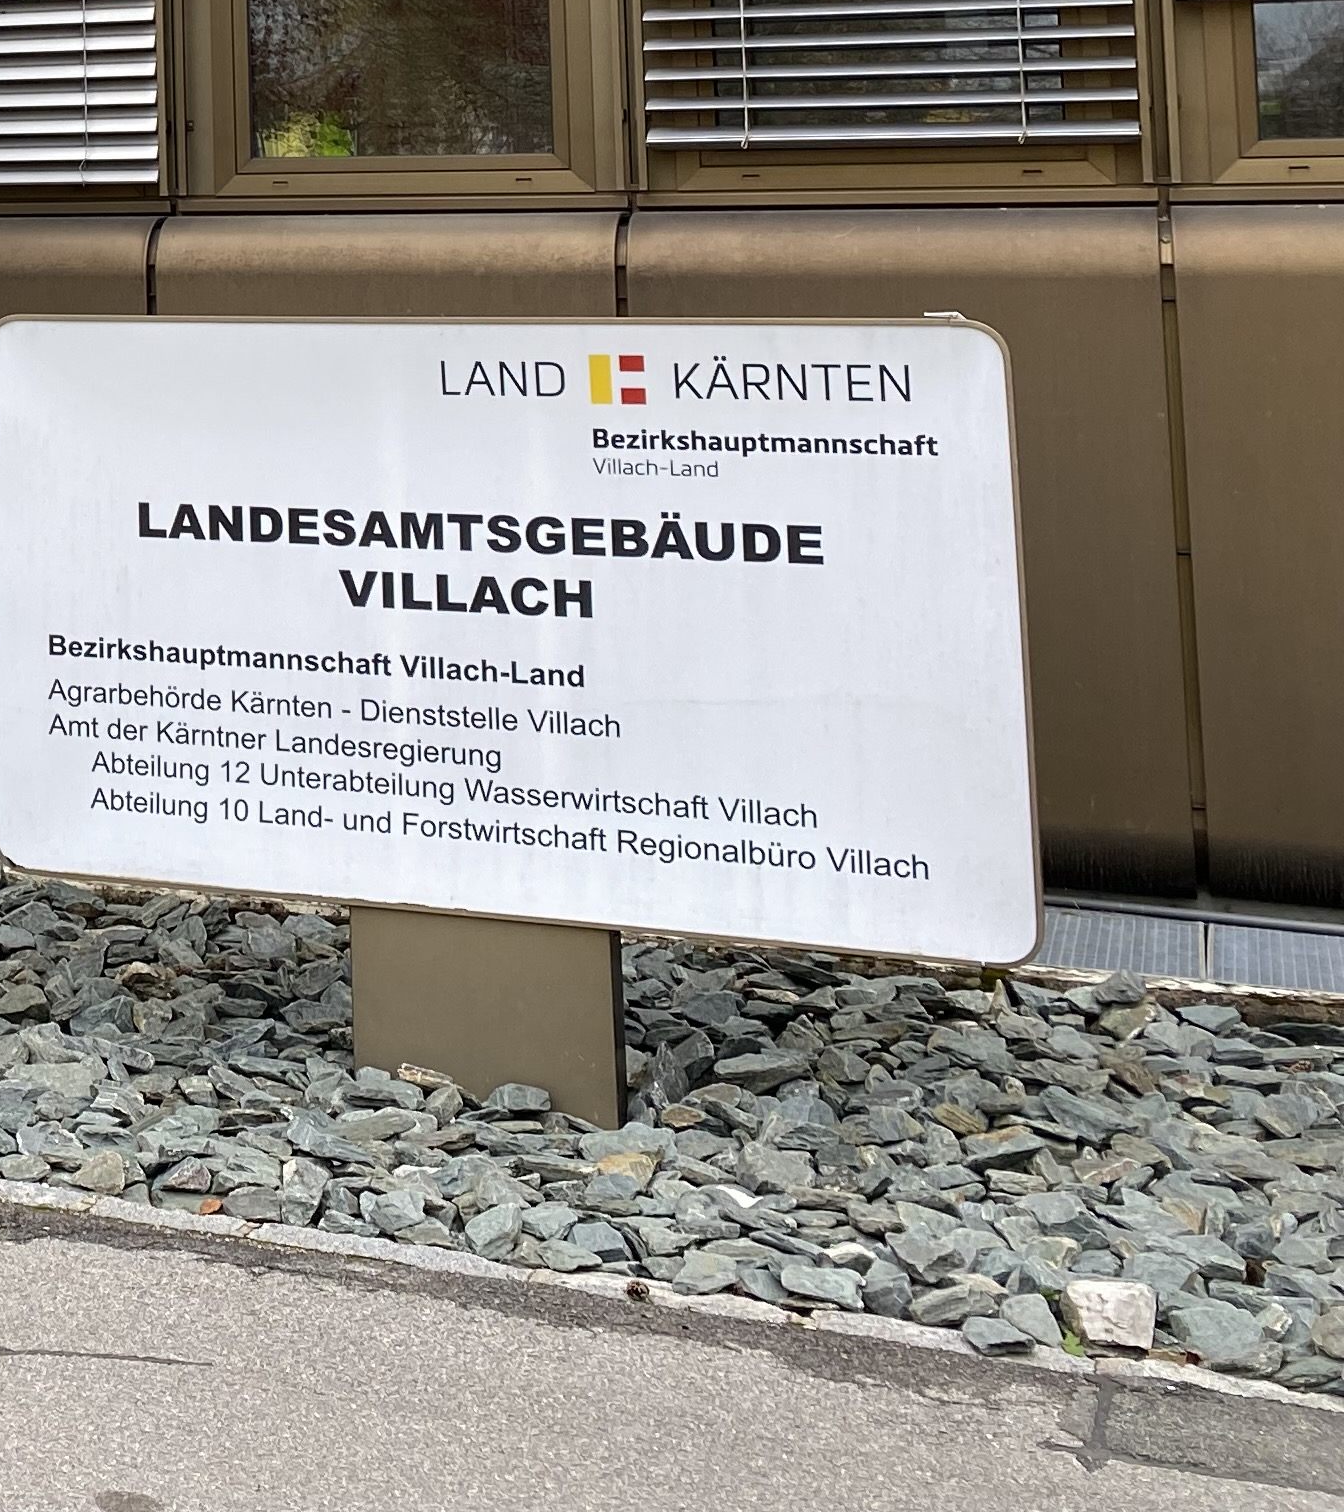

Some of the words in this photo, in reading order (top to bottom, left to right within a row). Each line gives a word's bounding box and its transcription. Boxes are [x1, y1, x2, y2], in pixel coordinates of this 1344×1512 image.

[440, 359, 566, 397] LAND
[673, 355, 912, 403] KÄRNTEN
[592, 427, 939, 458] Bezirkshauptmannschaft
[592, 457, 719, 478] Villach-Land
[137, 501, 825, 566] LANDESAMTSGEBÄUDE
[338, 568, 594, 619] VILLACH
[48, 633, 392, 677] Bezirkshauptmannschaft
[399, 654, 585, 688] Villach-Land
[47, 678, 222, 712] Agrarbehörde
[231, 689, 332, 720] Kärnten
[360, 698, 519, 732] Dienststelle
[526, 708, 621, 739] Villach
[48, 713, 100, 739] Amt
[106, 717, 149, 742] der
[156, 720, 268, 751] Kärntner
[275, 728, 502, 774] Landesregierung
[91, 750, 210, 787] Abteilung
[220, 759, 251, 785] 12
[260, 762, 455, 806] Unterabteilung
[463, 777, 710, 821] Wasserwirtschaft
[717, 796, 818, 829] Villach
[90, 787, 208, 825] Abteilung
[219, 797, 249, 822] 10
[258, 800, 334, 829] Land-
[343, 810, 392, 834] und
[402, 811, 608, 852] Forstwirtschaft
[617, 828, 817, 870] Regionalbüro
[825, 846, 930, 881] Villach
